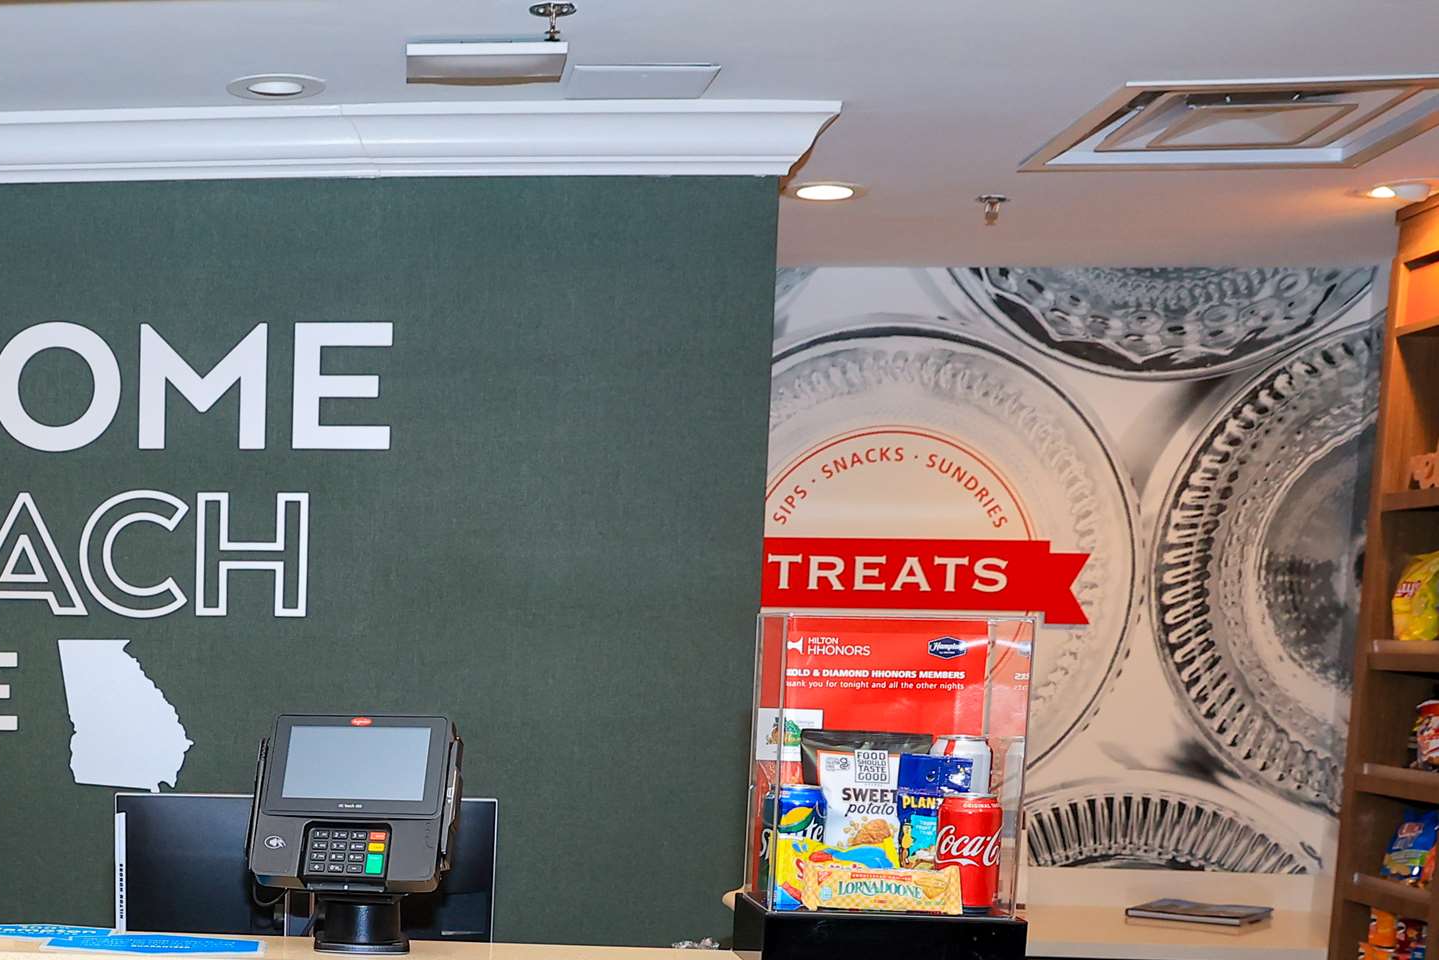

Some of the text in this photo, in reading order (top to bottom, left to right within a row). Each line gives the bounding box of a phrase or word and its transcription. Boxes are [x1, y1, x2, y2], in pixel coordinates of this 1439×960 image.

[773, 447, 1009, 529] SIPS SNACKS SUNDRIES
[767, 553, 1009, 593] TREATS
[807, 636, 839, 645] HILTON
[807, 645, 871, 656] HHONORS
[812, 668, 821, 677] &
[822, 669, 870, 678] DIAMOND
[871, 670, 917, 679] HHONORS
[918, 671, 966, 679] MEMBERS
[826, 680, 837, 688] for
[840, 681, 869, 690] tonight
[916, 682, 938, 690] other
[940, 683, 965, 691] nights
[857, 752, 886, 760] FOOD
[858, 765, 887, 773] TASTE
[858, 773, 887, 781] GOOD
[842, 787, 897, 803] SWEET
[845, 802, 895, 817] potato
[838, 880, 922, 898] LORNA DOONE
